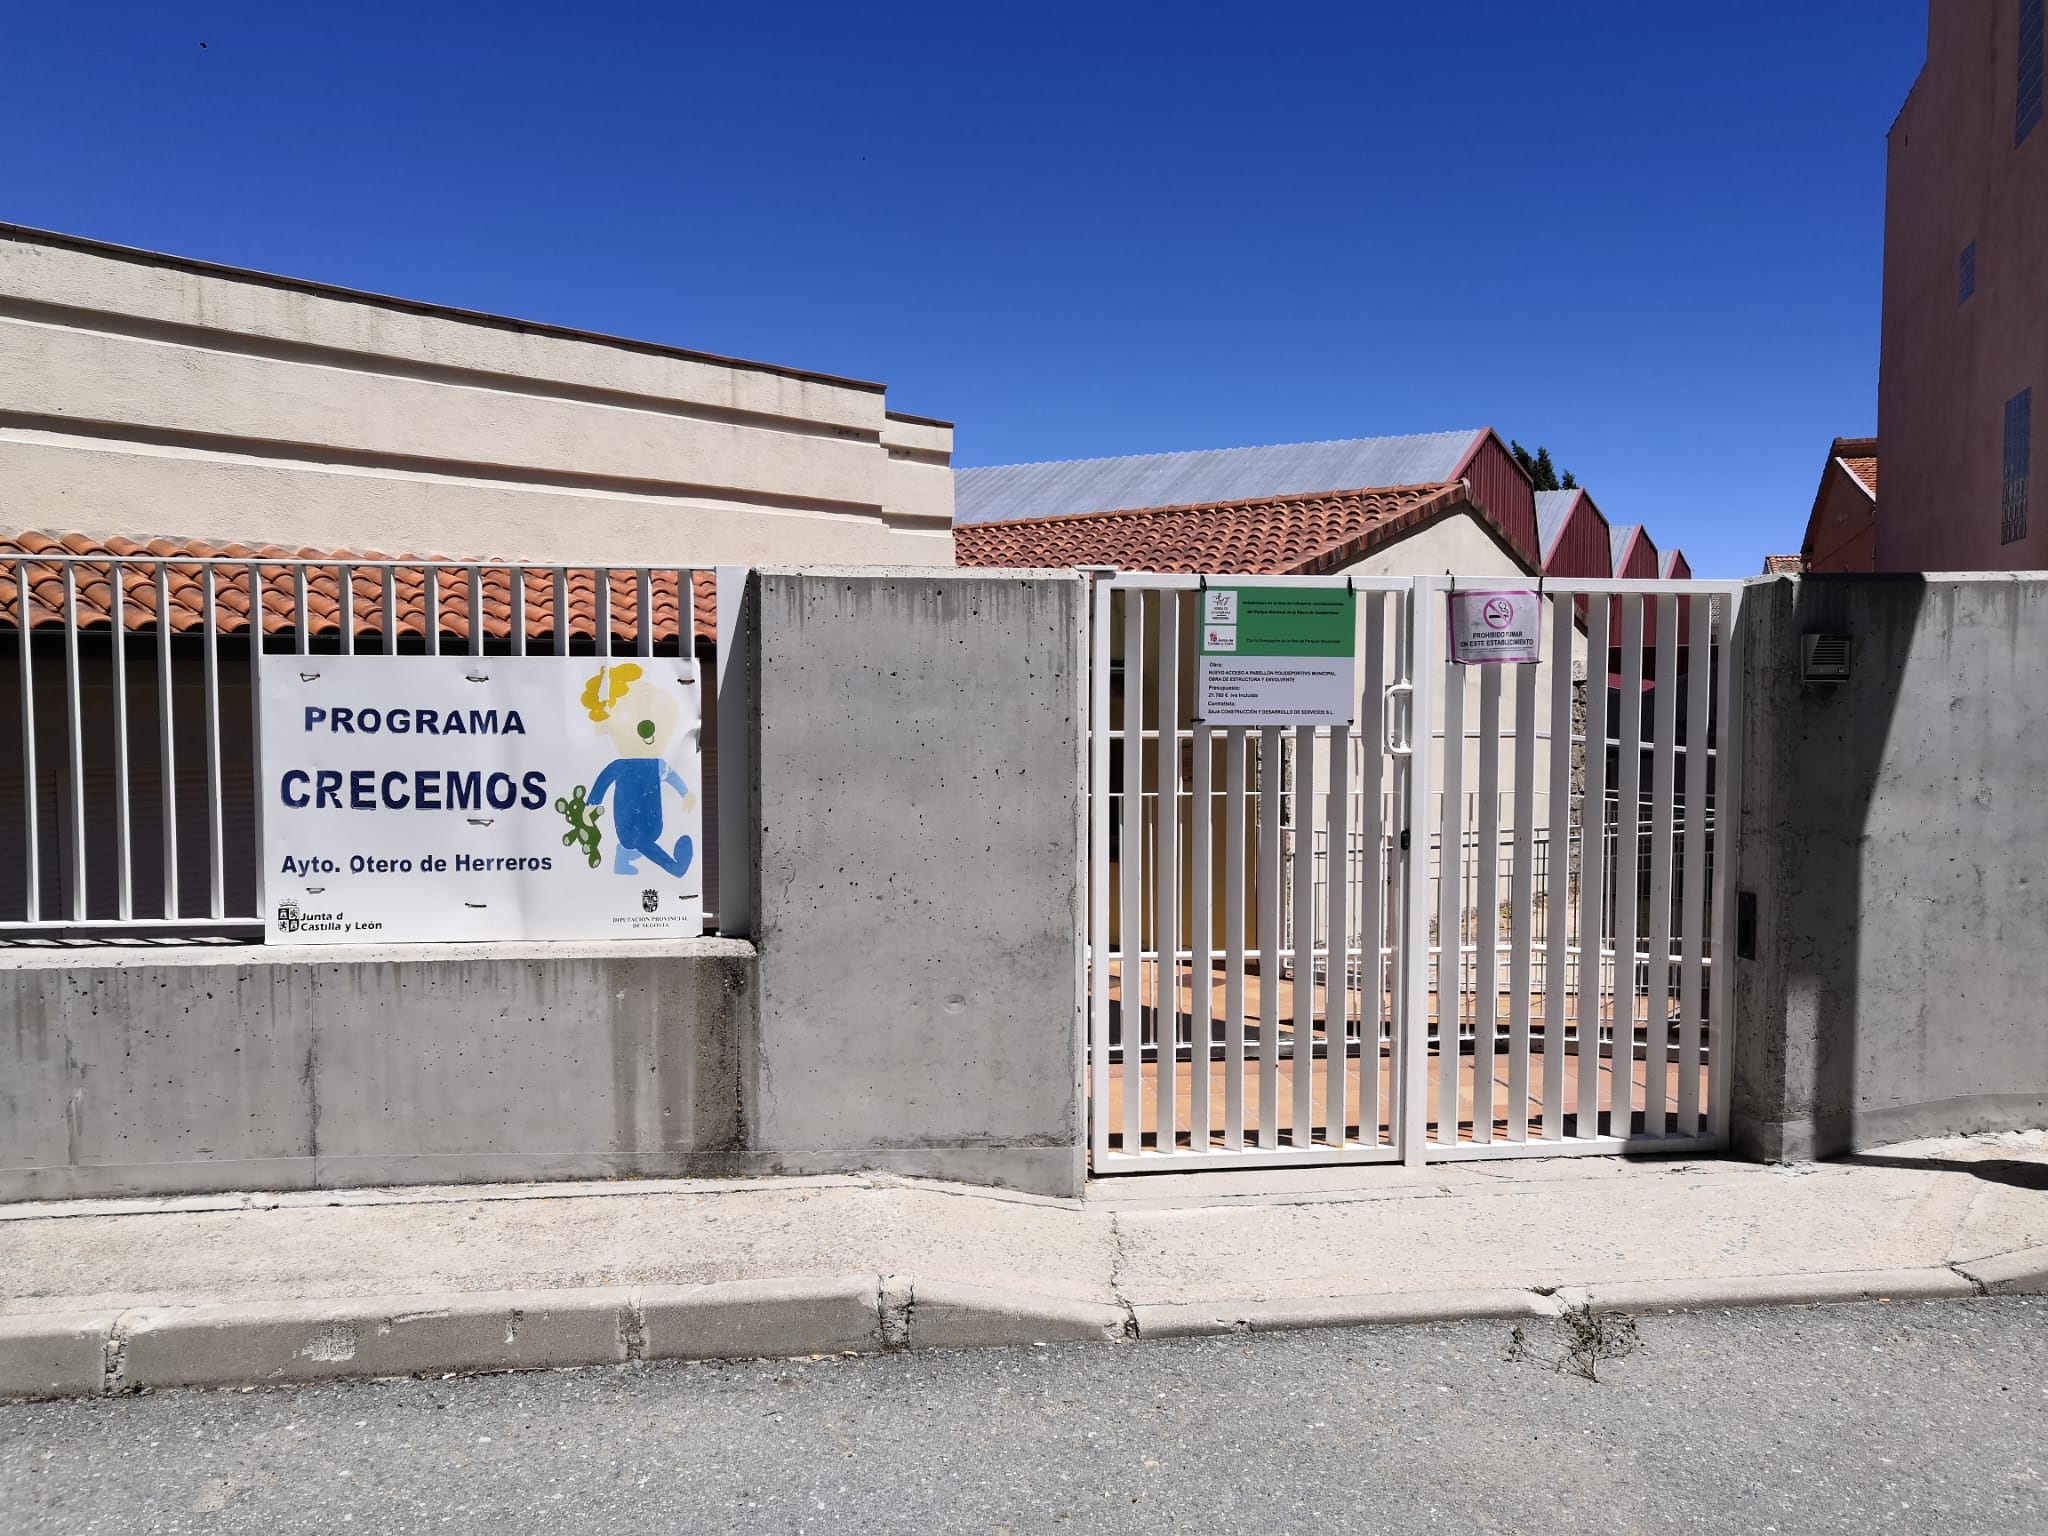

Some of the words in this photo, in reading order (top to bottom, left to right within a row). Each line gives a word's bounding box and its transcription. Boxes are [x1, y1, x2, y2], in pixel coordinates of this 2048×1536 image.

[304, 706, 526, 735] PROGRAMA
[280, 769, 547, 811] CRECEMOS
[281, 855, 341, 878] Ayto.
[350, 854, 413, 875] Otero
[420, 854, 447, 874] de
[455, 853, 552, 873] Herreros
[300, 912, 332, 921] Junta
[300, 922, 341, 931] Castilla
[345, 923, 352, 932] y
[355, 921, 382, 930] León
